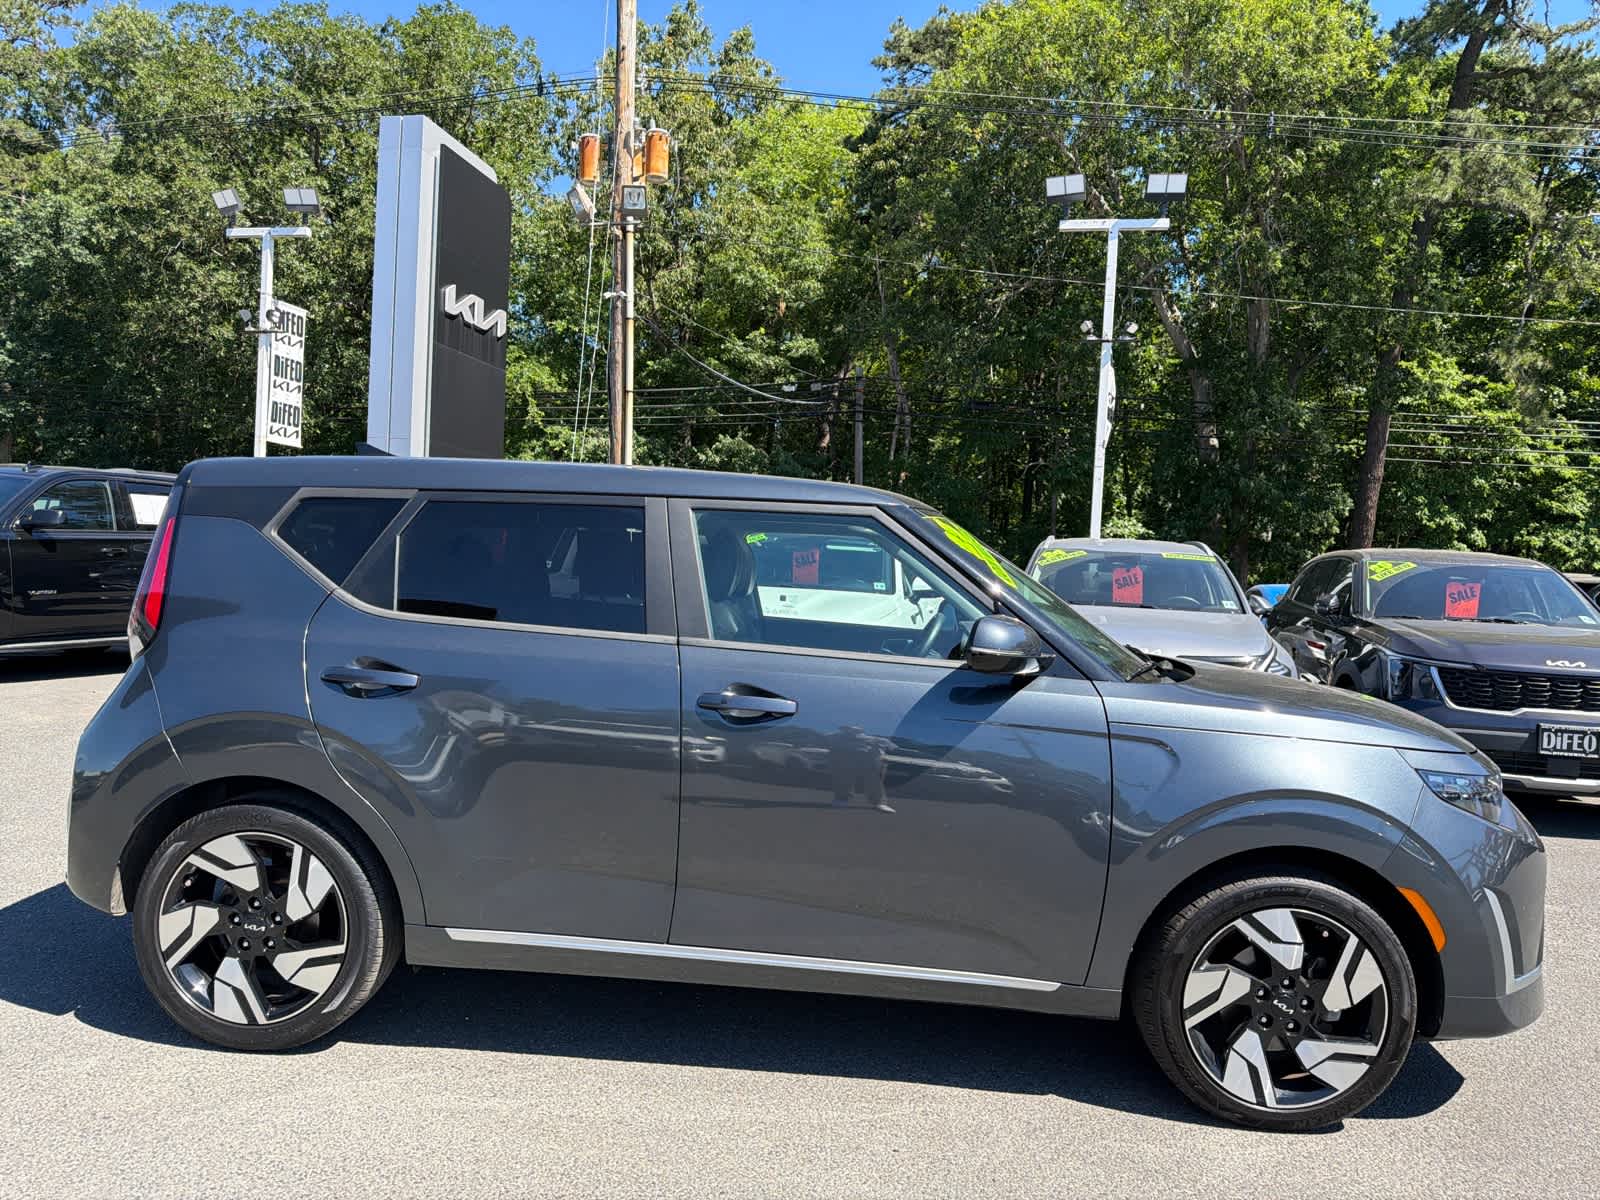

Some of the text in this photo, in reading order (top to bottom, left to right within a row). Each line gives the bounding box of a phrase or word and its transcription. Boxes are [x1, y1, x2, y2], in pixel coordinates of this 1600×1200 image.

[444, 284, 507, 338] KIA
[274, 332, 303, 349] KIA
[273, 354, 303, 383] DiFEO
[273, 379, 302, 394] KIA
[270, 401, 301, 428] DiFEO
[269, 425, 300, 439] KIA
[794, 550, 817, 568] SALE
[1115, 573, 1141, 590] SALE
[1448, 586, 1478, 604] SALE
[1545, 659, 1587, 668] KIA
[1542, 731, 1598, 753] DiFEO
[243, 923, 267, 932] KIA
[1272, 999, 1295, 1015] KIA
